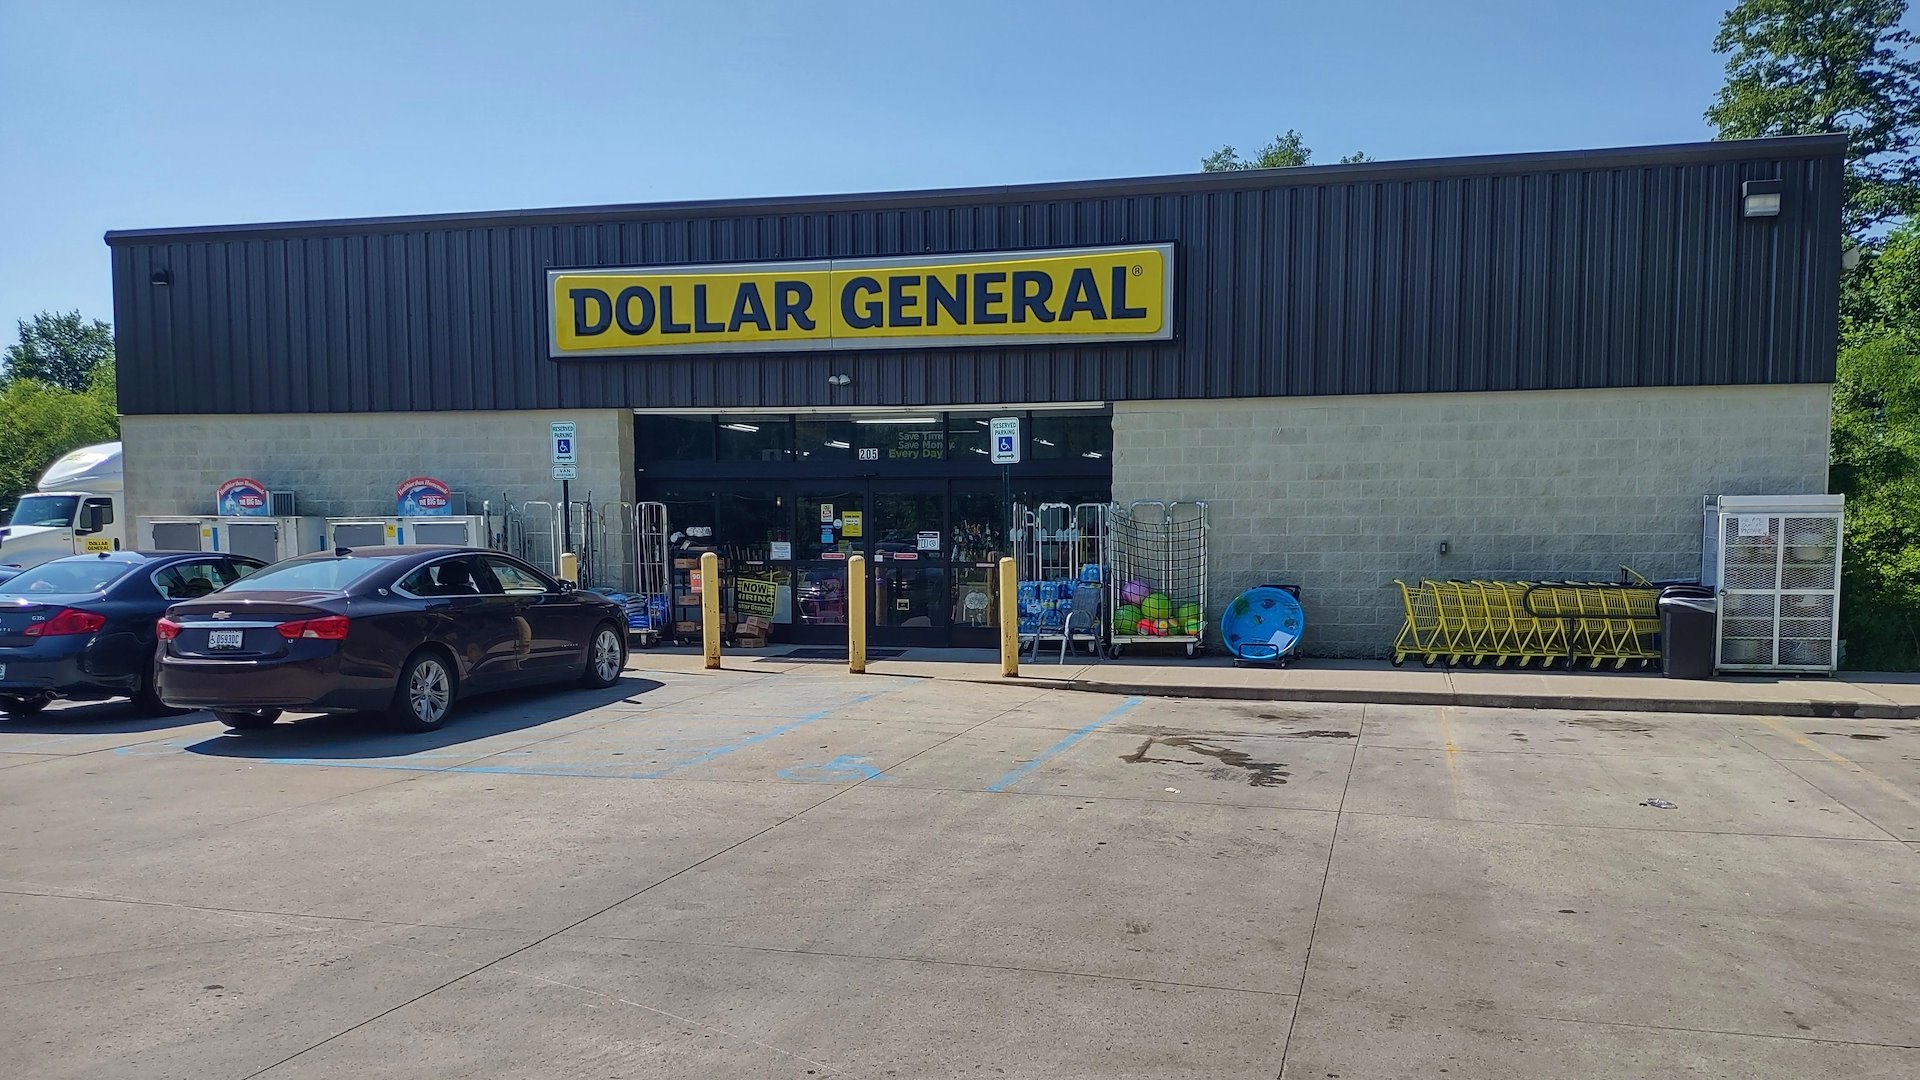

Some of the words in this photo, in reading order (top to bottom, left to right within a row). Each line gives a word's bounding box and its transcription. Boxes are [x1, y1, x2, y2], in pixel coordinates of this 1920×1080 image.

[569, 281, 816, 336] DOLLAR
[840, 266, 1147, 330] GENERAL
[898, 432, 920, 440] Save
[898, 440, 920, 449] Save
[922, 440, 955, 450] Mony.
[860, 449, 878, 459] 205
[888, 448, 920, 459] Every
[427, 498, 437, 506] BIG
[743, 582, 767, 594] NOW
